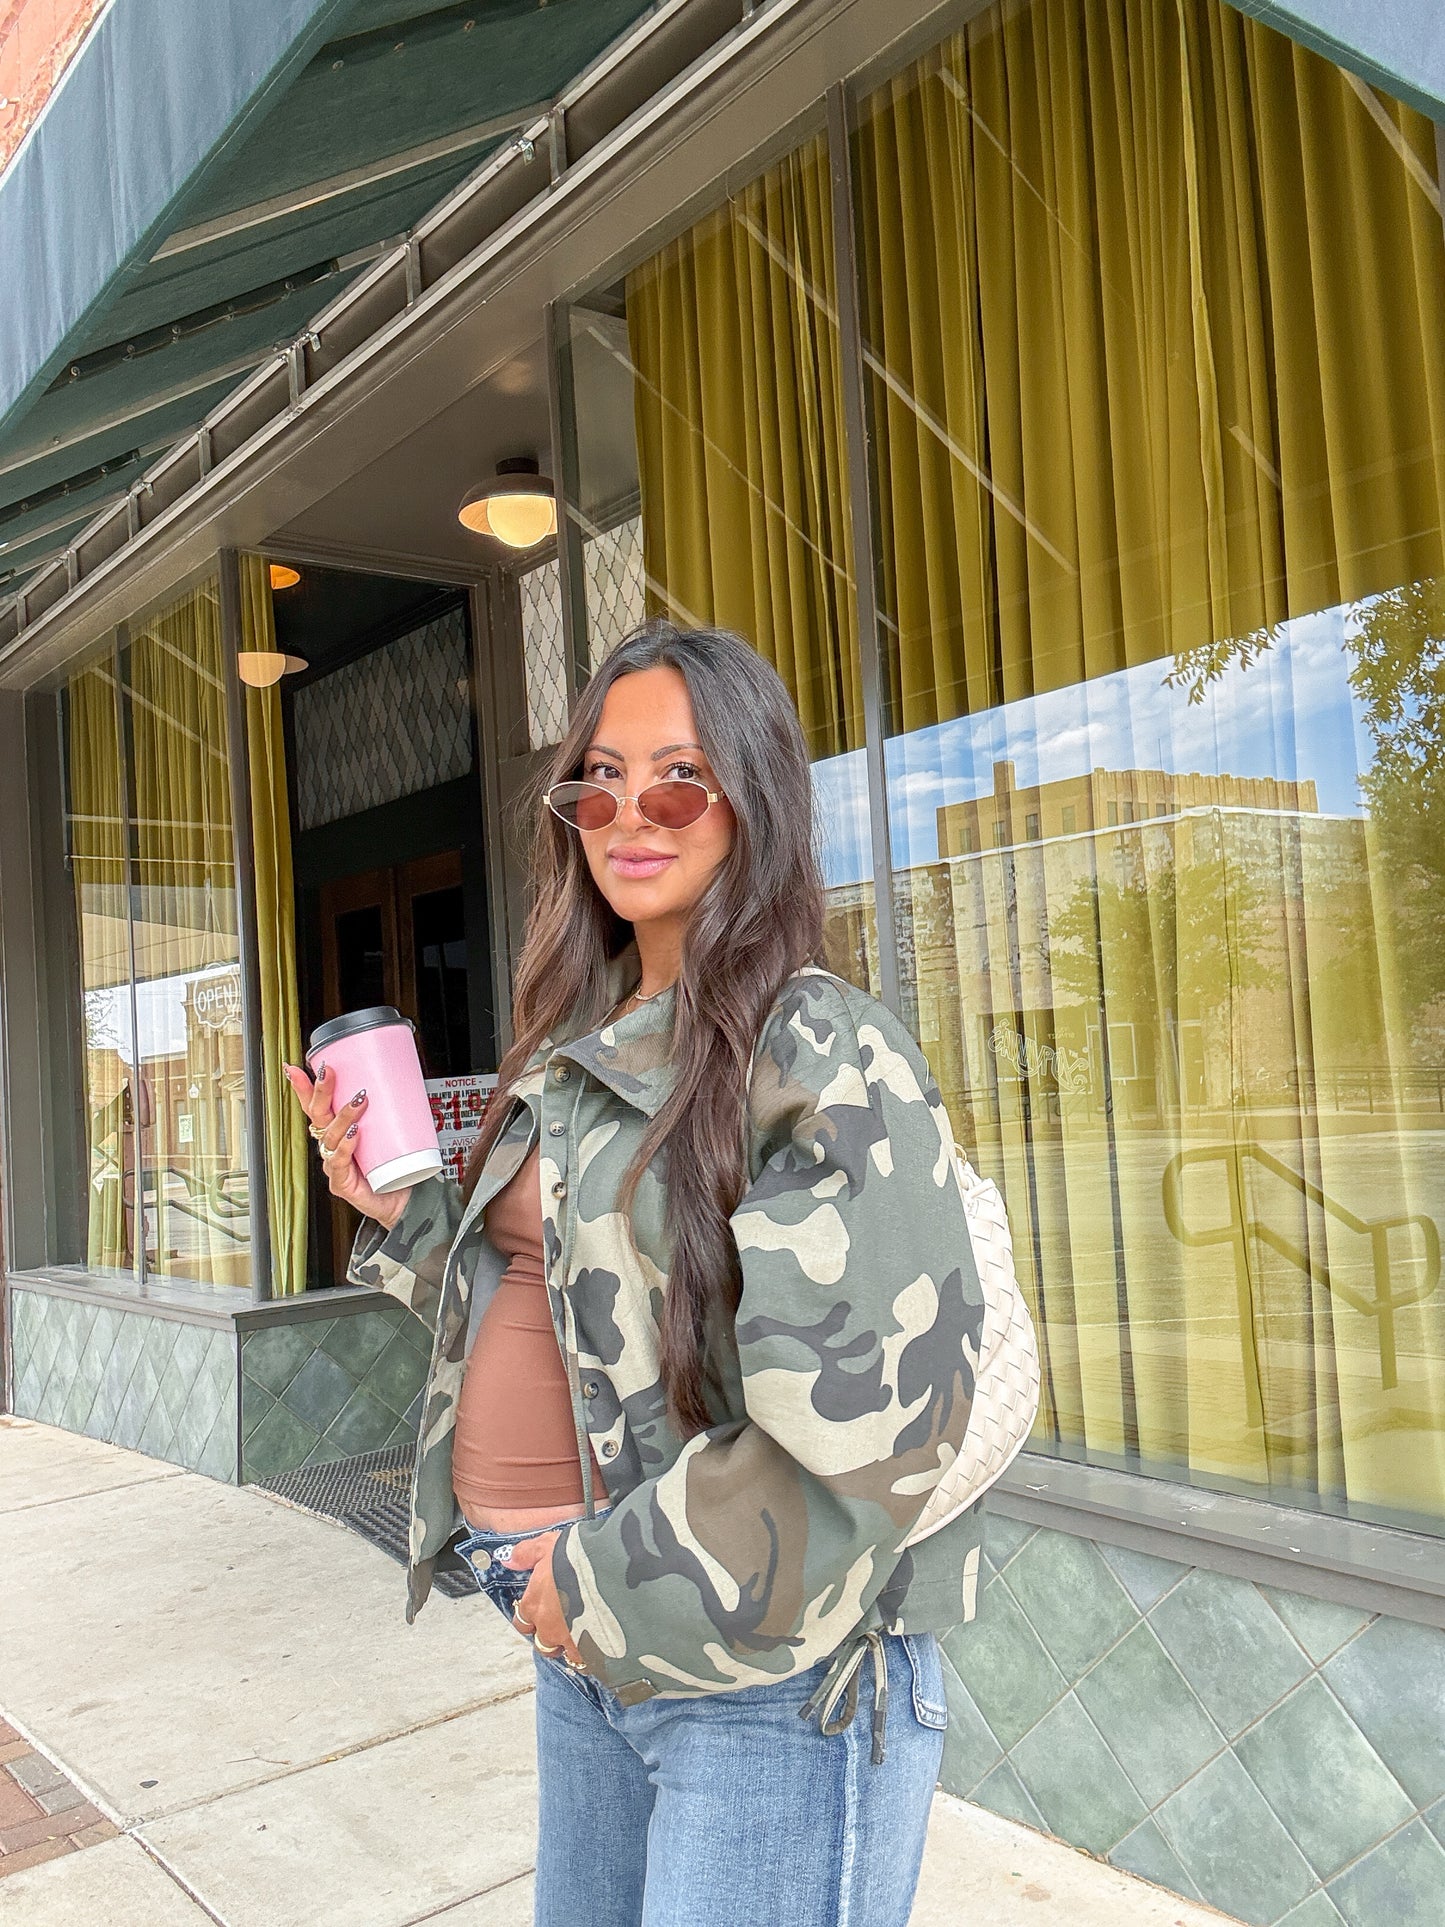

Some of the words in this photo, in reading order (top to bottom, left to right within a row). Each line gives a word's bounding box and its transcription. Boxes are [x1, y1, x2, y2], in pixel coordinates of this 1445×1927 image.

[198, 984, 233, 1012] OPEN
[445, 1078, 477, 1088] NOTICE
[452, 1137, 476, 1148] AVISO
